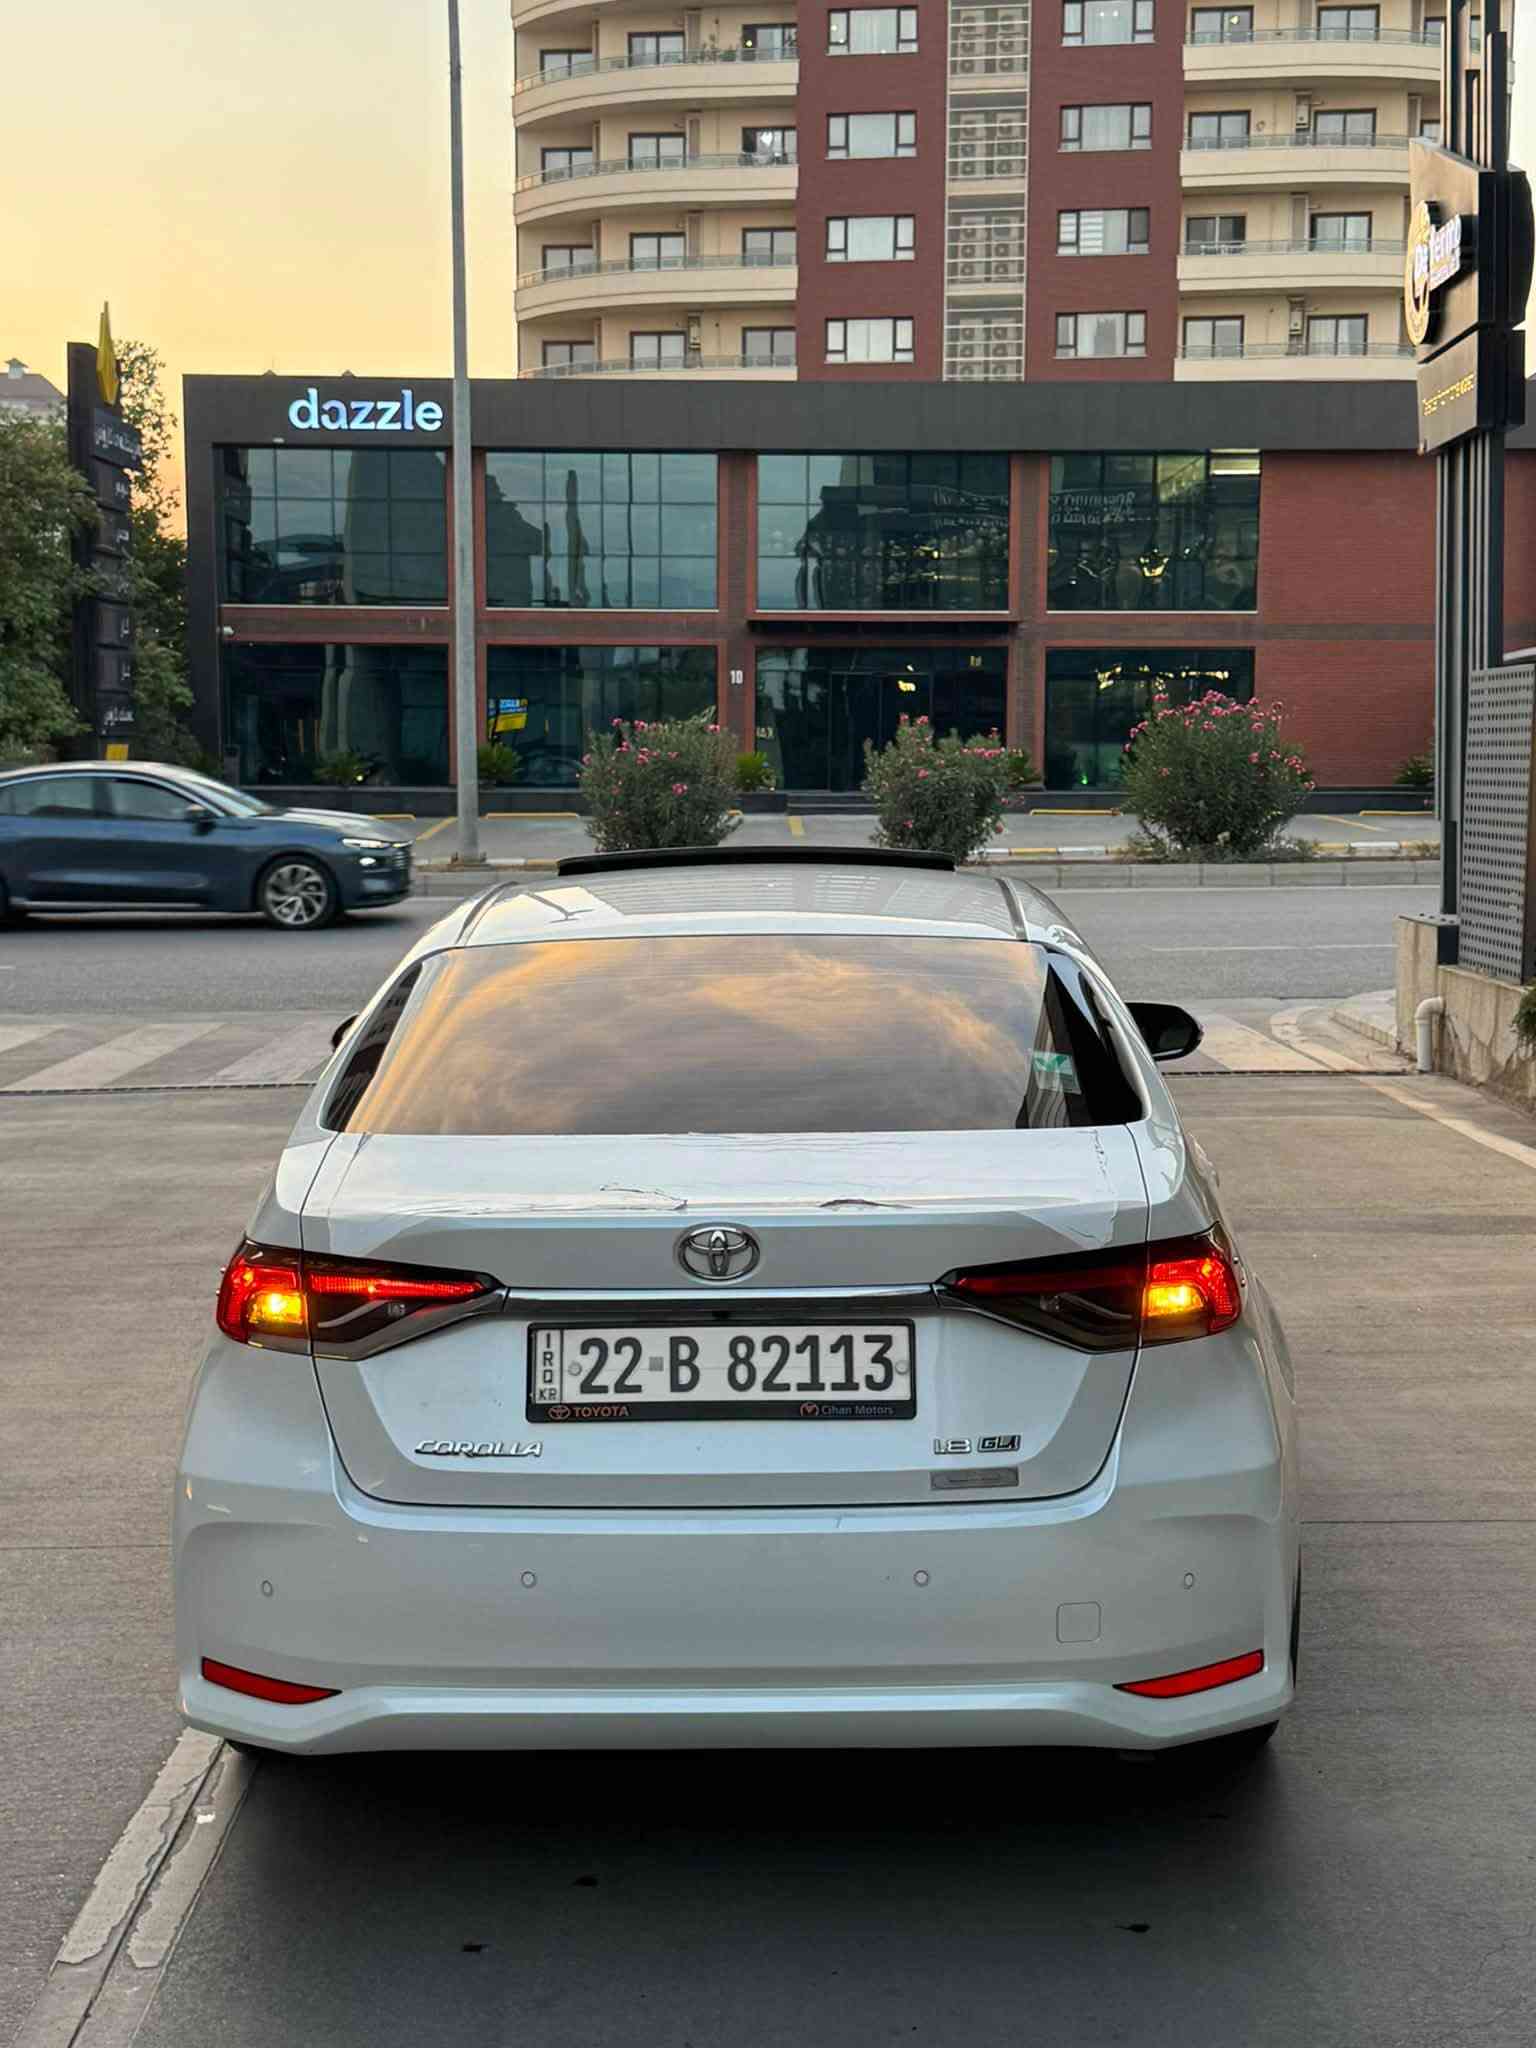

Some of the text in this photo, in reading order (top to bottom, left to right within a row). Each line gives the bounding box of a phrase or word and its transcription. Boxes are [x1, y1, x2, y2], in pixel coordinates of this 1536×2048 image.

[288, 387, 443, 431] dazzle
[730, 669, 743, 684] 10
[579, 1334, 893, 1394] 22 B 82113
[573, 1406, 630, 1417] TOYOTA
[821, 1404, 894, 1416] Cihan Motors
[415, 1440, 542, 1457] COROLLA
